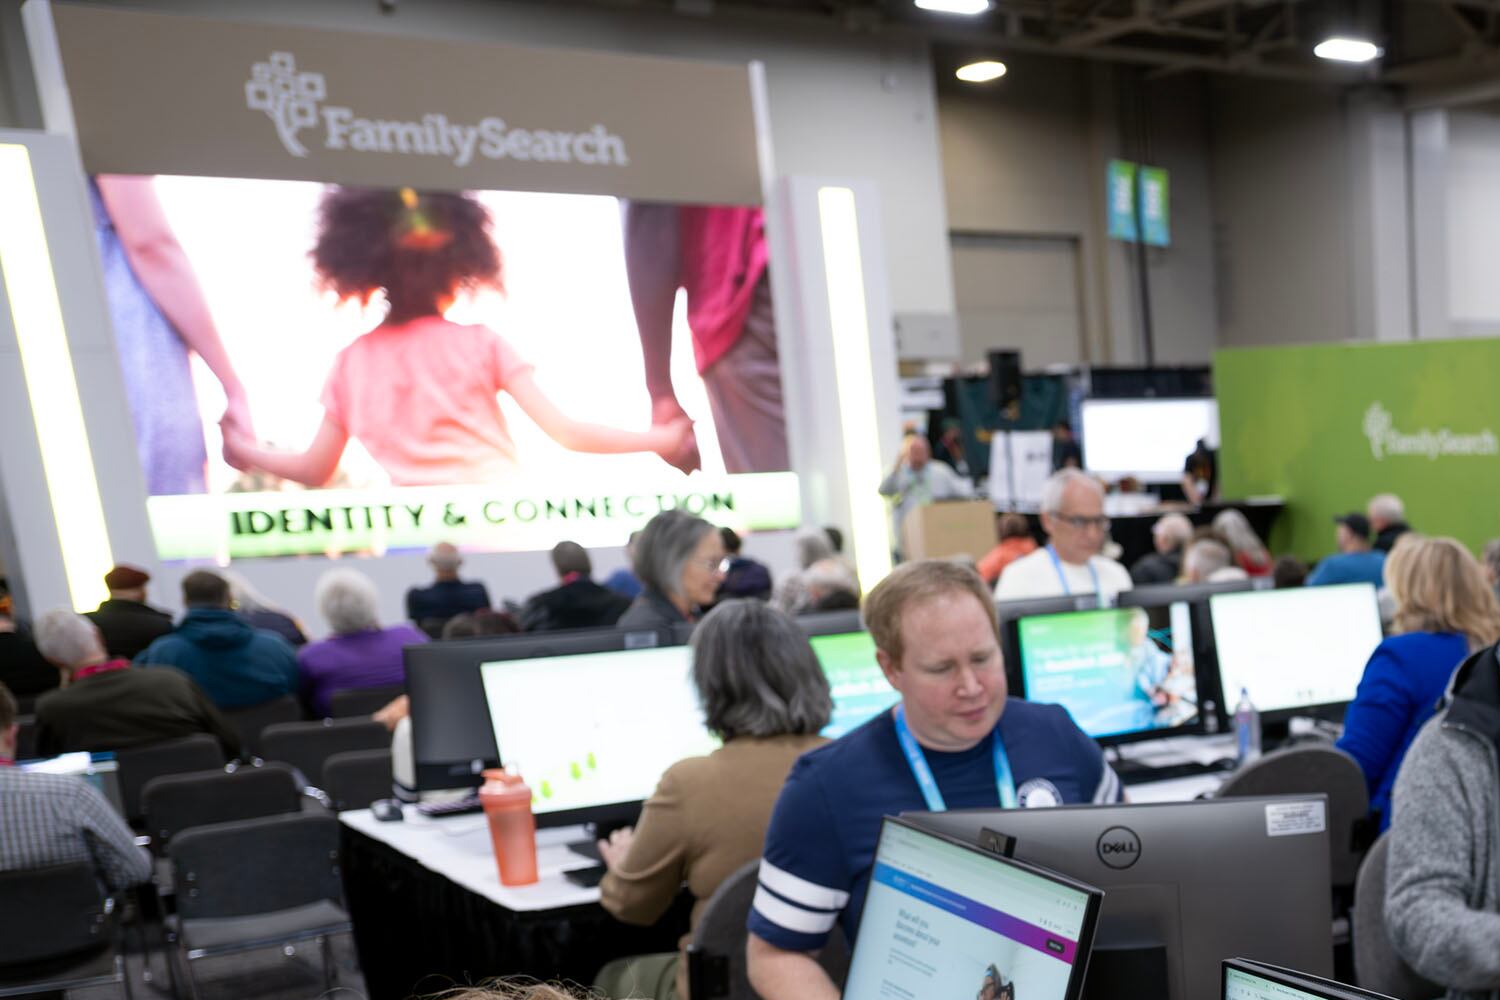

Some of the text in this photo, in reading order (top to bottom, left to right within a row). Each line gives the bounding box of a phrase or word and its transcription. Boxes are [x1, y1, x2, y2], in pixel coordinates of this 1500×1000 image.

[322, 107, 629, 166] FamilySearch
[230, 491, 736, 536] IDENTITY & CONNECTION
[1102, 842, 1137, 855] DELL
